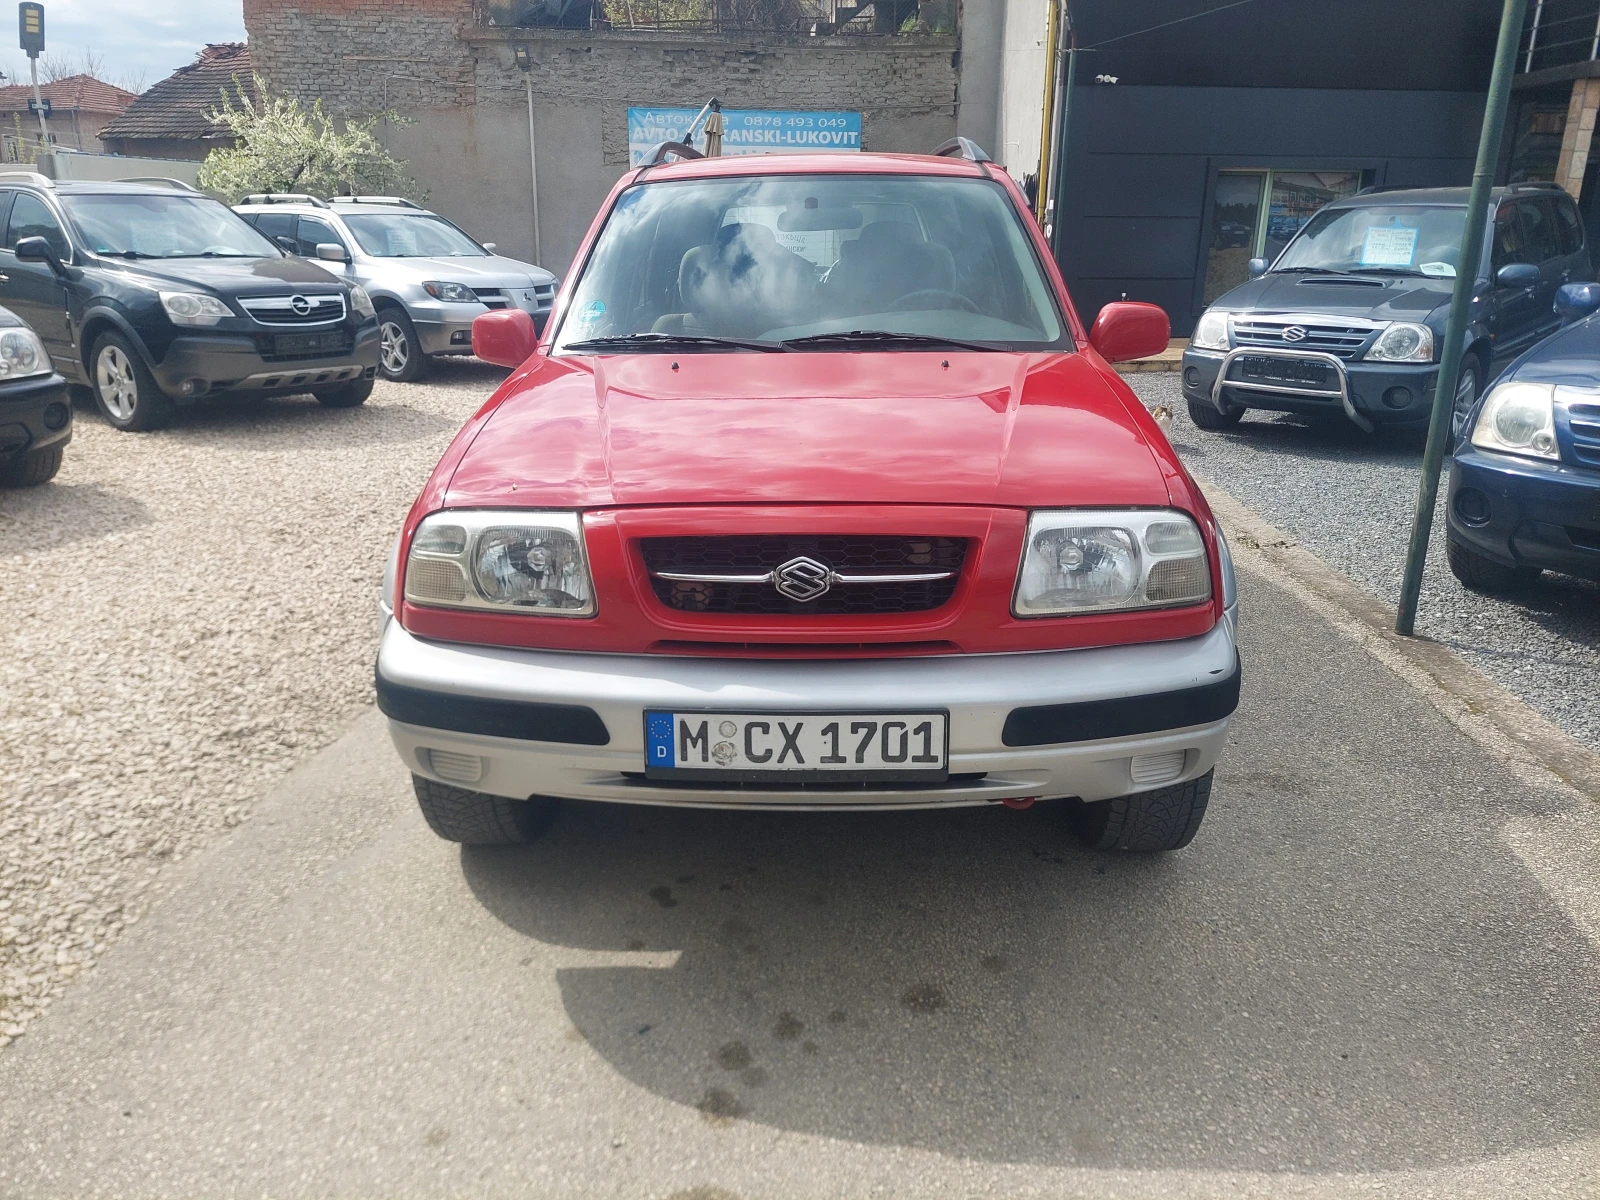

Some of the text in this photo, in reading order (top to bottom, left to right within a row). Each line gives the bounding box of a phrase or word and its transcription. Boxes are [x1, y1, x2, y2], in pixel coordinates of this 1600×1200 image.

[643, 111, 847, 128] Автокъа 0878 493 049
[632, 127, 859, 144] AVTO-AKANSKI-LUKOVIT
[679, 719, 939, 764] M CX 1701
[656, 745, 667, 758] D
